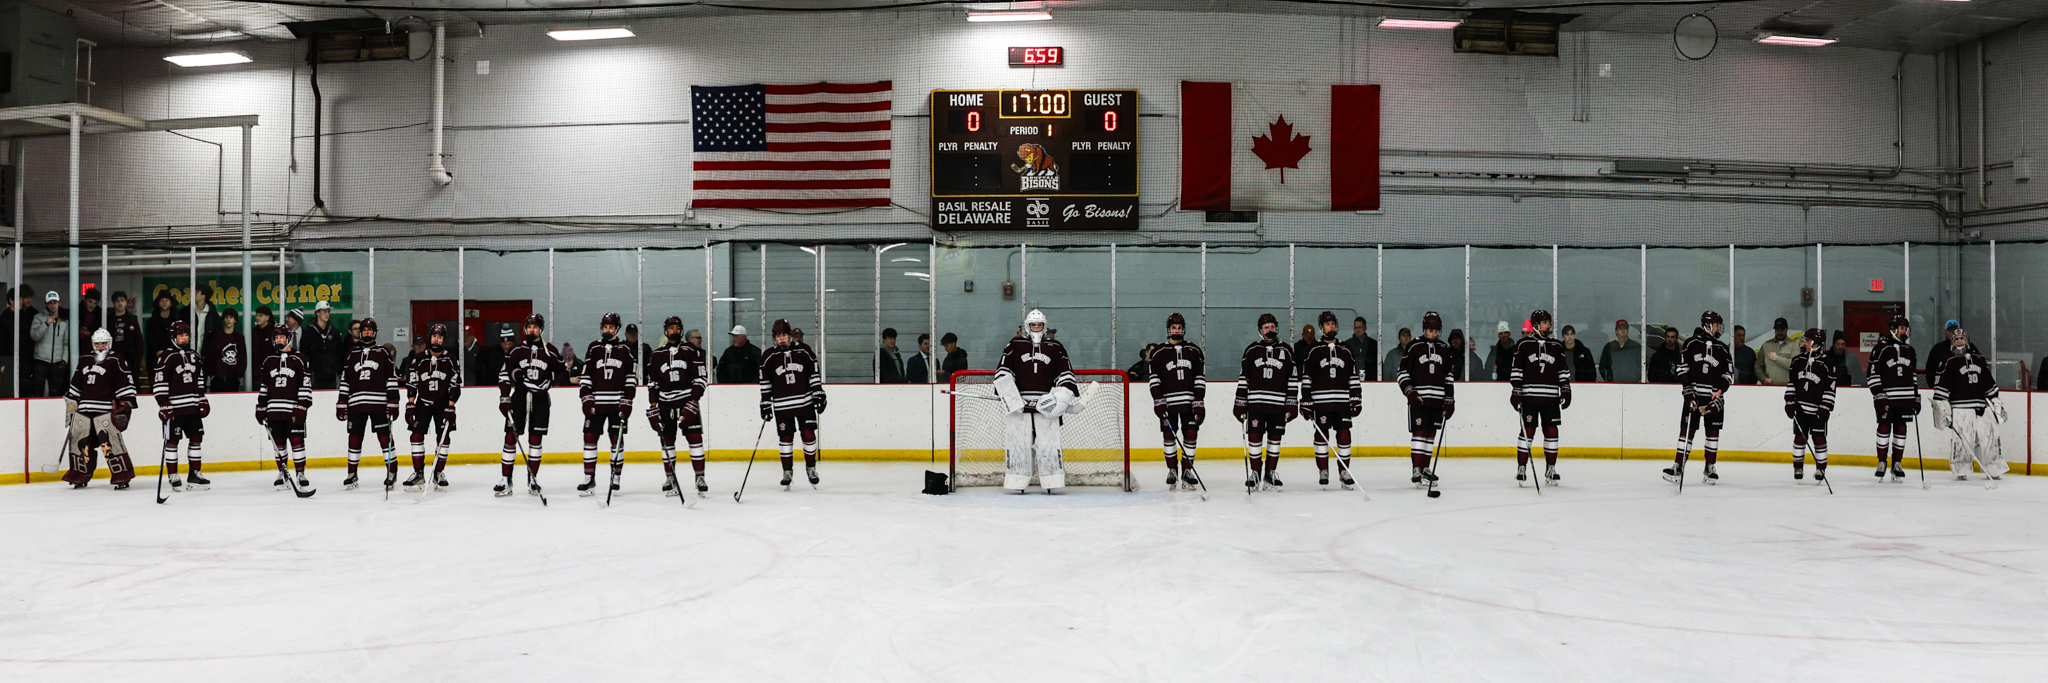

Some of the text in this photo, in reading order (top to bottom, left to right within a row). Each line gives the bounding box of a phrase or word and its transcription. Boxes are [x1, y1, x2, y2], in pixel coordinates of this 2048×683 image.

[950, 94, 984, 106] HOME
[1012, 94, 1066, 114] 17:00
[1084, 94, 1122, 106] GUEST
[967, 111, 980, 132] 0
[1104, 111, 1117, 132] 0
[1010, 126, 1038, 135] PERIOD
[1047, 124, 1052, 136] 1
[938, 142, 998, 151] PLYR PENALTY
[1072, 142, 1131, 150] PLYR PENALTY
[1021, 176, 1059, 190] BISONS
[938, 202, 1011, 212] BASIL RESALE
[1062, 204, 1133, 222] Go Bisons!
[938, 213, 1011, 225] DELAWARE
[152, 280, 342, 306] Coahes Corner
[698, 366, 706, 376] 16
[1034, 363, 1037, 373] 1
[1263, 368, 1273, 378] 10
[1330, 368, 1336, 378] 9
[1429, 364, 1435, 374] 8
[1539, 363, 1545, 373] 7
[1702, 364, 1709, 374] 6
[1897, 367, 1903, 376] 2
[87, 374, 95, 384] 31
[183, 373, 193, 383] 26
[359, 370, 370, 380] 22
[527, 369, 538, 380] 20
[604, 369, 613, 379] 17
[669, 371, 679, 382] 16
[786, 373, 795, 384] 13
[1177, 369, 1184, 380] 11
[1968, 374, 1978, 384] 30
[275, 377, 287, 387] 23
[429, 380, 438, 391] 21
[1803, 381, 1808, 392] 4
[1830, 381, 1836, 390] 4
